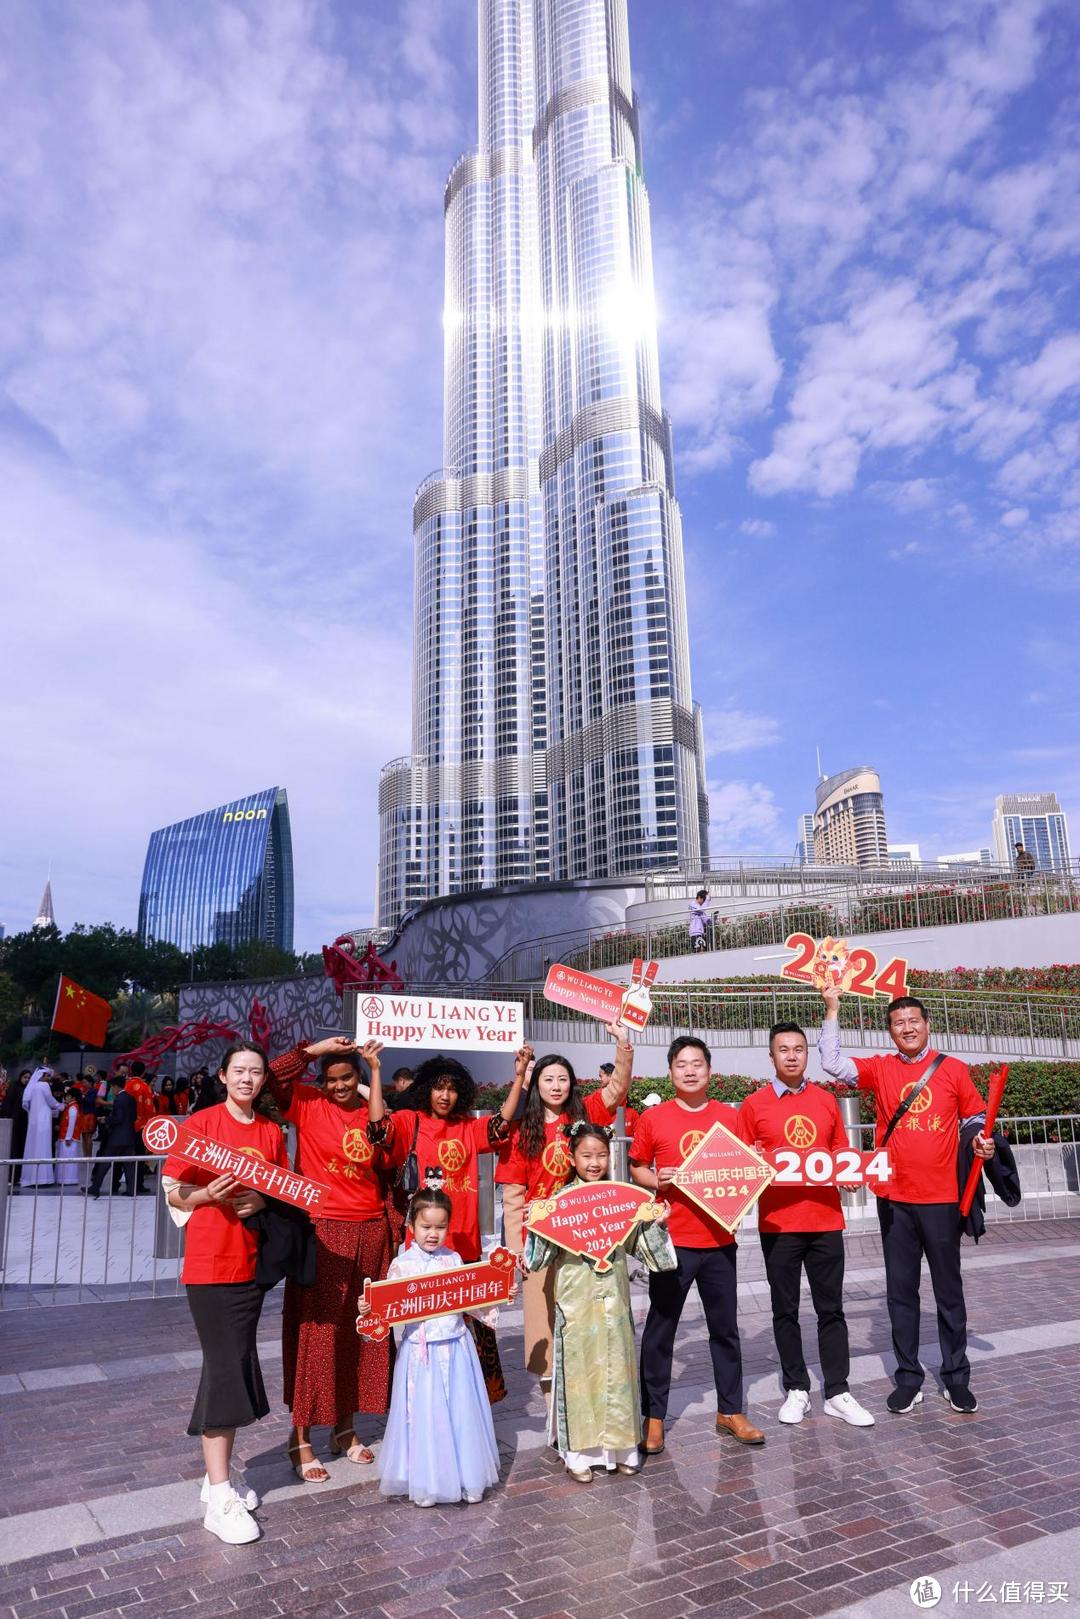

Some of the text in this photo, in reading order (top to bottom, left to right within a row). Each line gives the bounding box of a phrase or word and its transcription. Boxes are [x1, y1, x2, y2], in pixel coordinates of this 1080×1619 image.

[223, 808, 267, 823] noon
[548, 982, 620, 1014] Happy New Year
[367, 1021, 517, 1042] Happy New Year
[183, 1137, 322, 1206] 五洲同庆中国年
[677, 1165, 771, 1185] 五洲同庆中国年
[774, 1151, 892, 1182] 2024
[703, 1185, 749, 1199] 2024
[551, 1200, 637, 1228] Happy Chinese
[572, 1219, 626, 1241] New Year
[585, 1237, 613, 1253] 2024
[383, 1280, 504, 1320] 五洲同庆中国年
[358, 1317, 379, 1328] 2024
